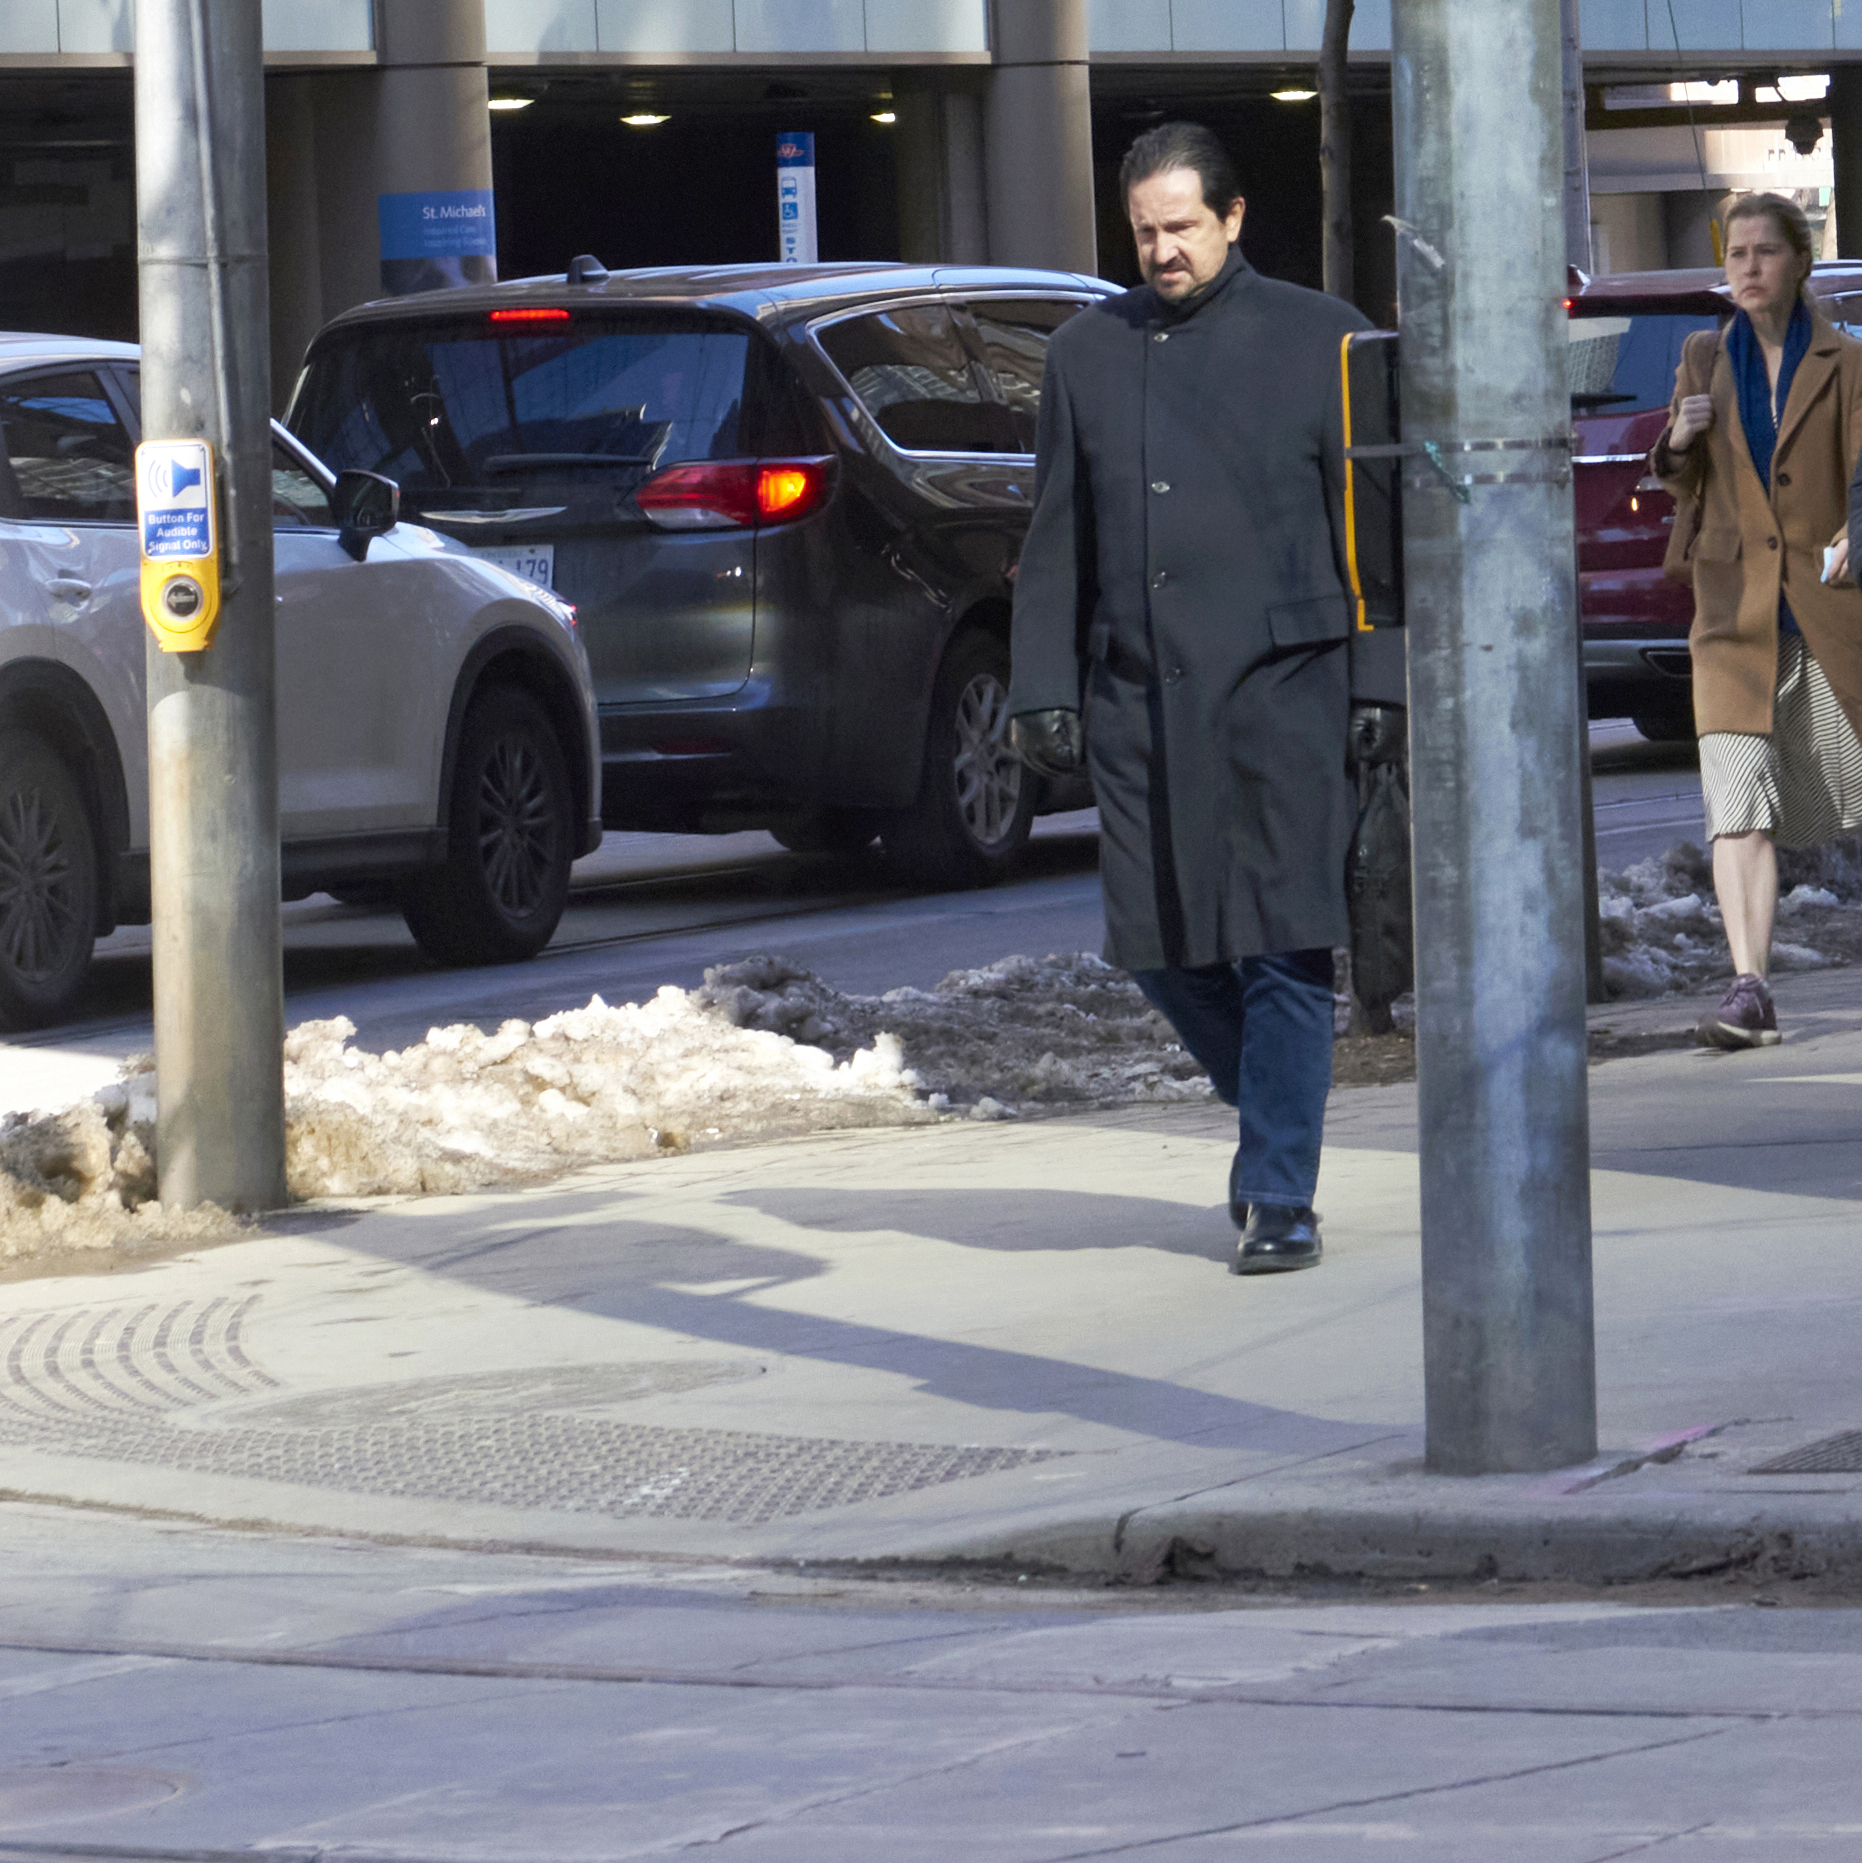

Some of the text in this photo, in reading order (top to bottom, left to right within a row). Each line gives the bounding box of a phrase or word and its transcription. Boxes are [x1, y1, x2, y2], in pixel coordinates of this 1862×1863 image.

[148, 512, 205, 525] Button For
[156, 526, 198, 538] Audible
[148, 541, 181, 554] Signal
